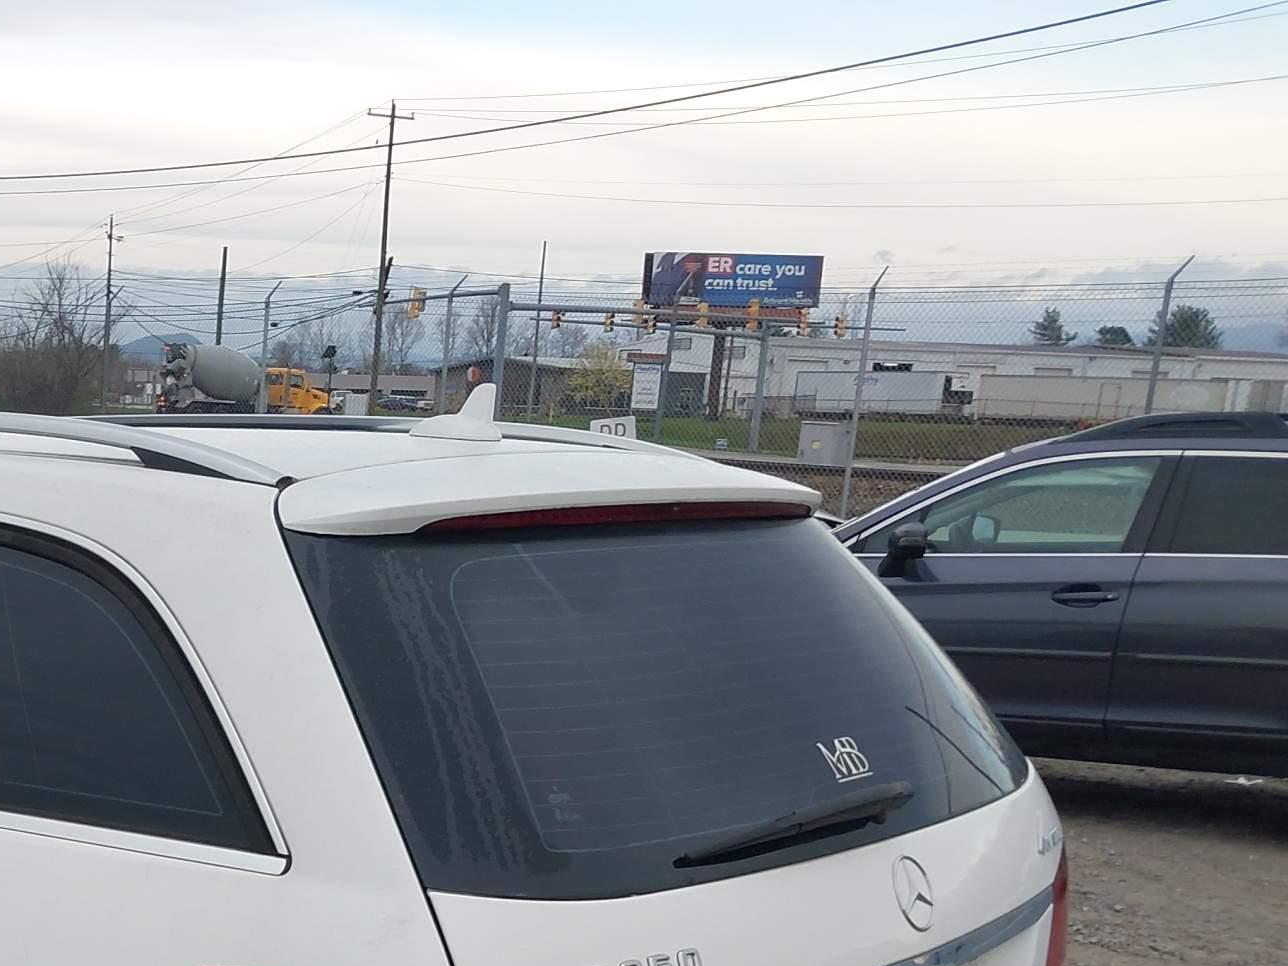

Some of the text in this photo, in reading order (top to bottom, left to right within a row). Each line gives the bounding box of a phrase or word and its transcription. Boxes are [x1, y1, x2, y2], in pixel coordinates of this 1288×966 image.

[708, 257, 805, 278] ER care you
[704, 278, 733, 290] can
